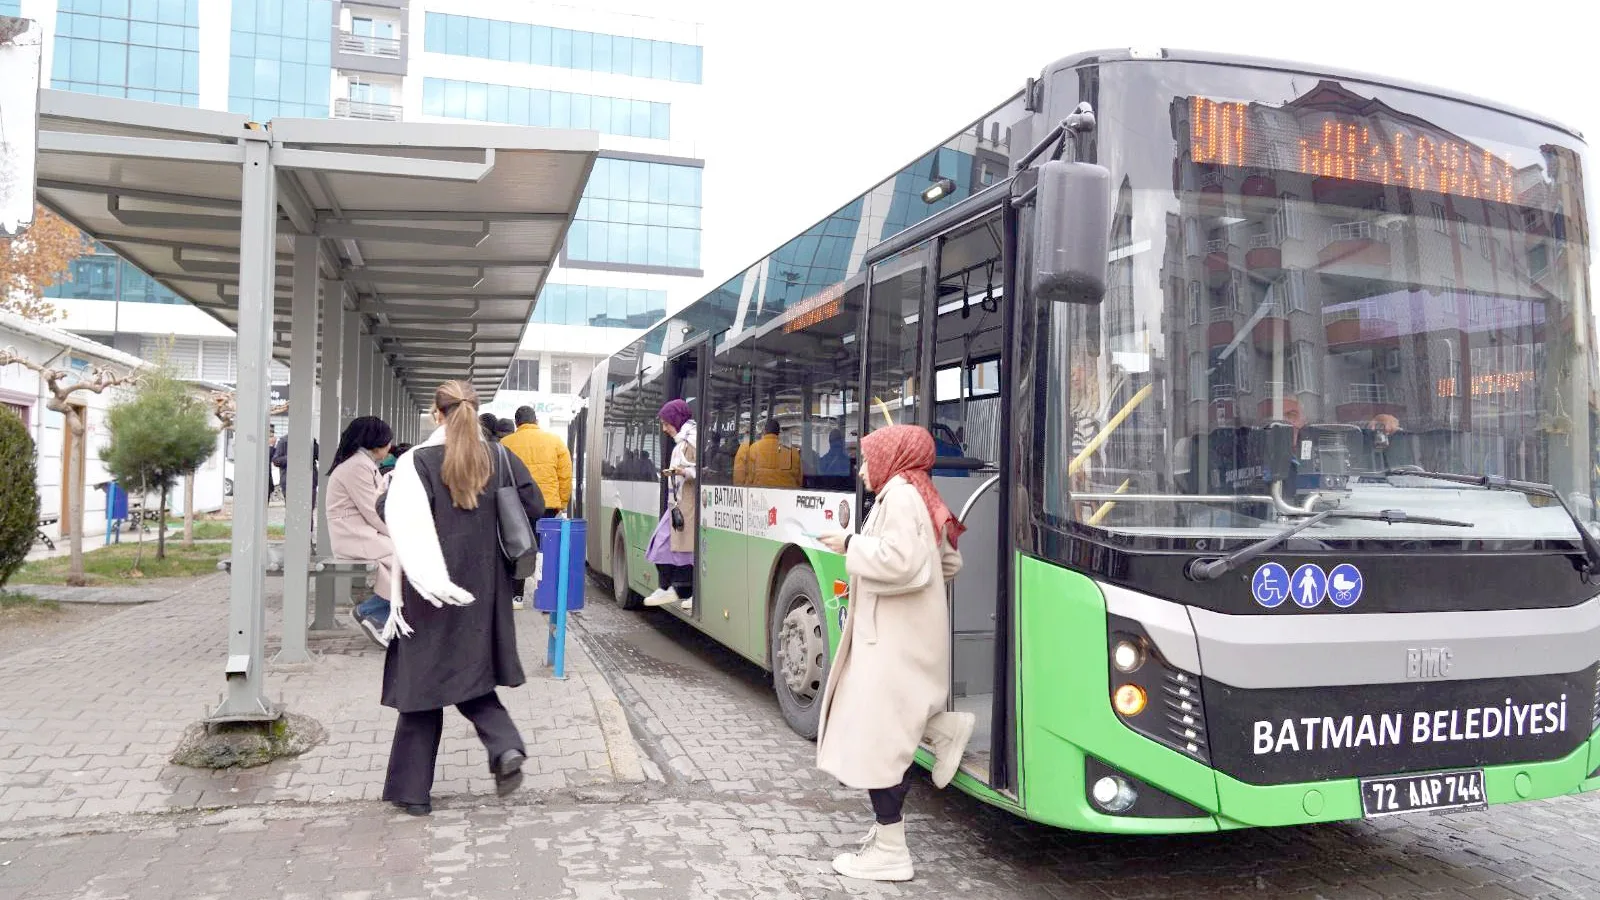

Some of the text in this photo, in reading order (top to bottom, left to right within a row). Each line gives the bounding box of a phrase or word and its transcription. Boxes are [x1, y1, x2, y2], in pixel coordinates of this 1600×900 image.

[714, 487, 744, 508] BATMAN
[1407, 647, 1452, 679] BMC
[1253, 693, 1567, 755] BATMAN BELEDİYESİ
[1372, 783, 1398, 812] 72
[1408, 779, 1442, 807] AAP
[1445, 774, 1481, 803] 744
